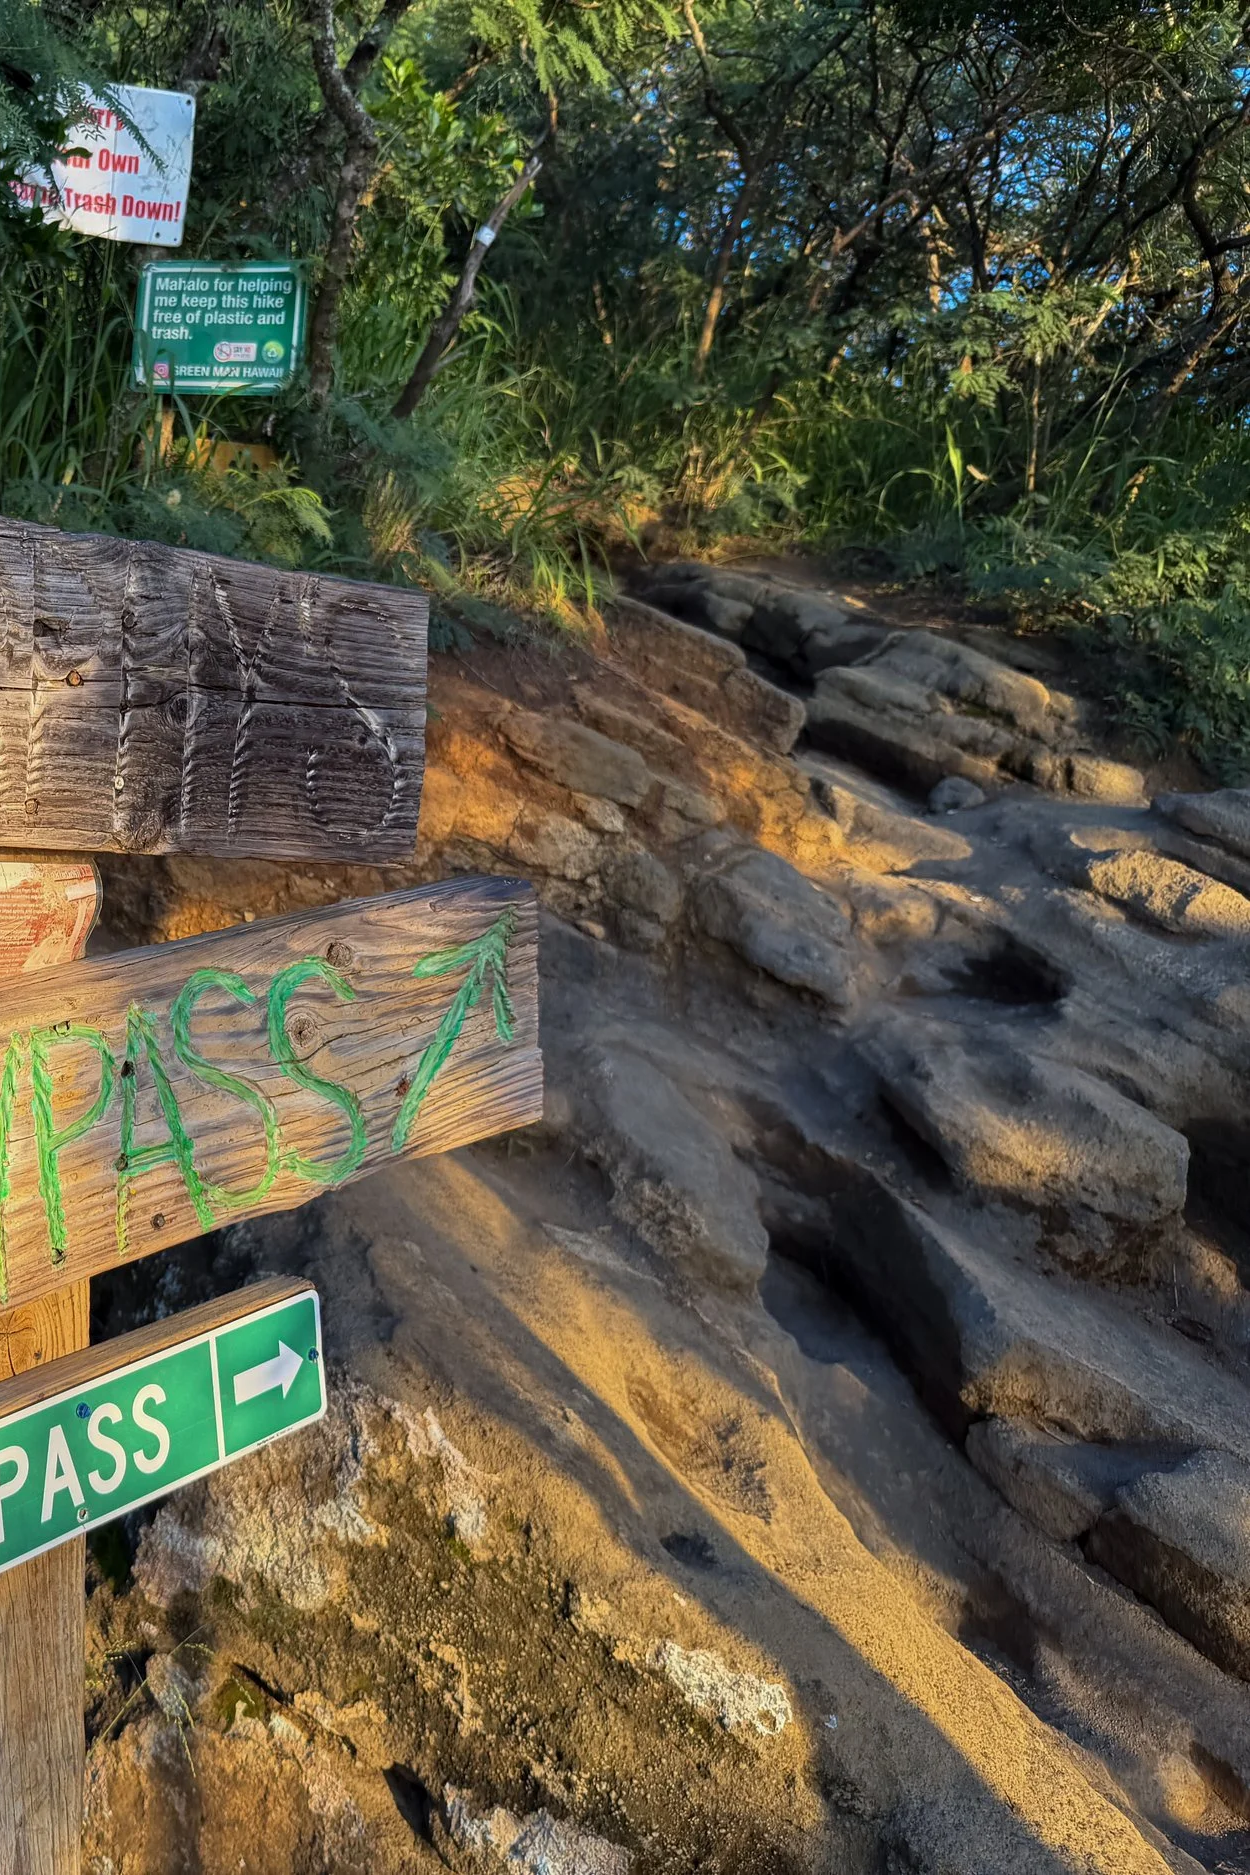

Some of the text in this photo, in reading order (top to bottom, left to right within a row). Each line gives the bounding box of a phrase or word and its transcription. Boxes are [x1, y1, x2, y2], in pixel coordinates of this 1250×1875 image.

[98, 148, 141, 175] Own
[64, 187, 117, 215] Trash
[121, 194, 182, 223] Down!
[155, 278, 293, 294] Mahalo for helping
[154, 294, 284, 310] me keep this hike
[152, 310, 285, 326] free of plastic and
[151, 326, 193, 340] trash.
[212, 366, 240, 378] MAN
[243, 366, 284, 378] HAWAII
